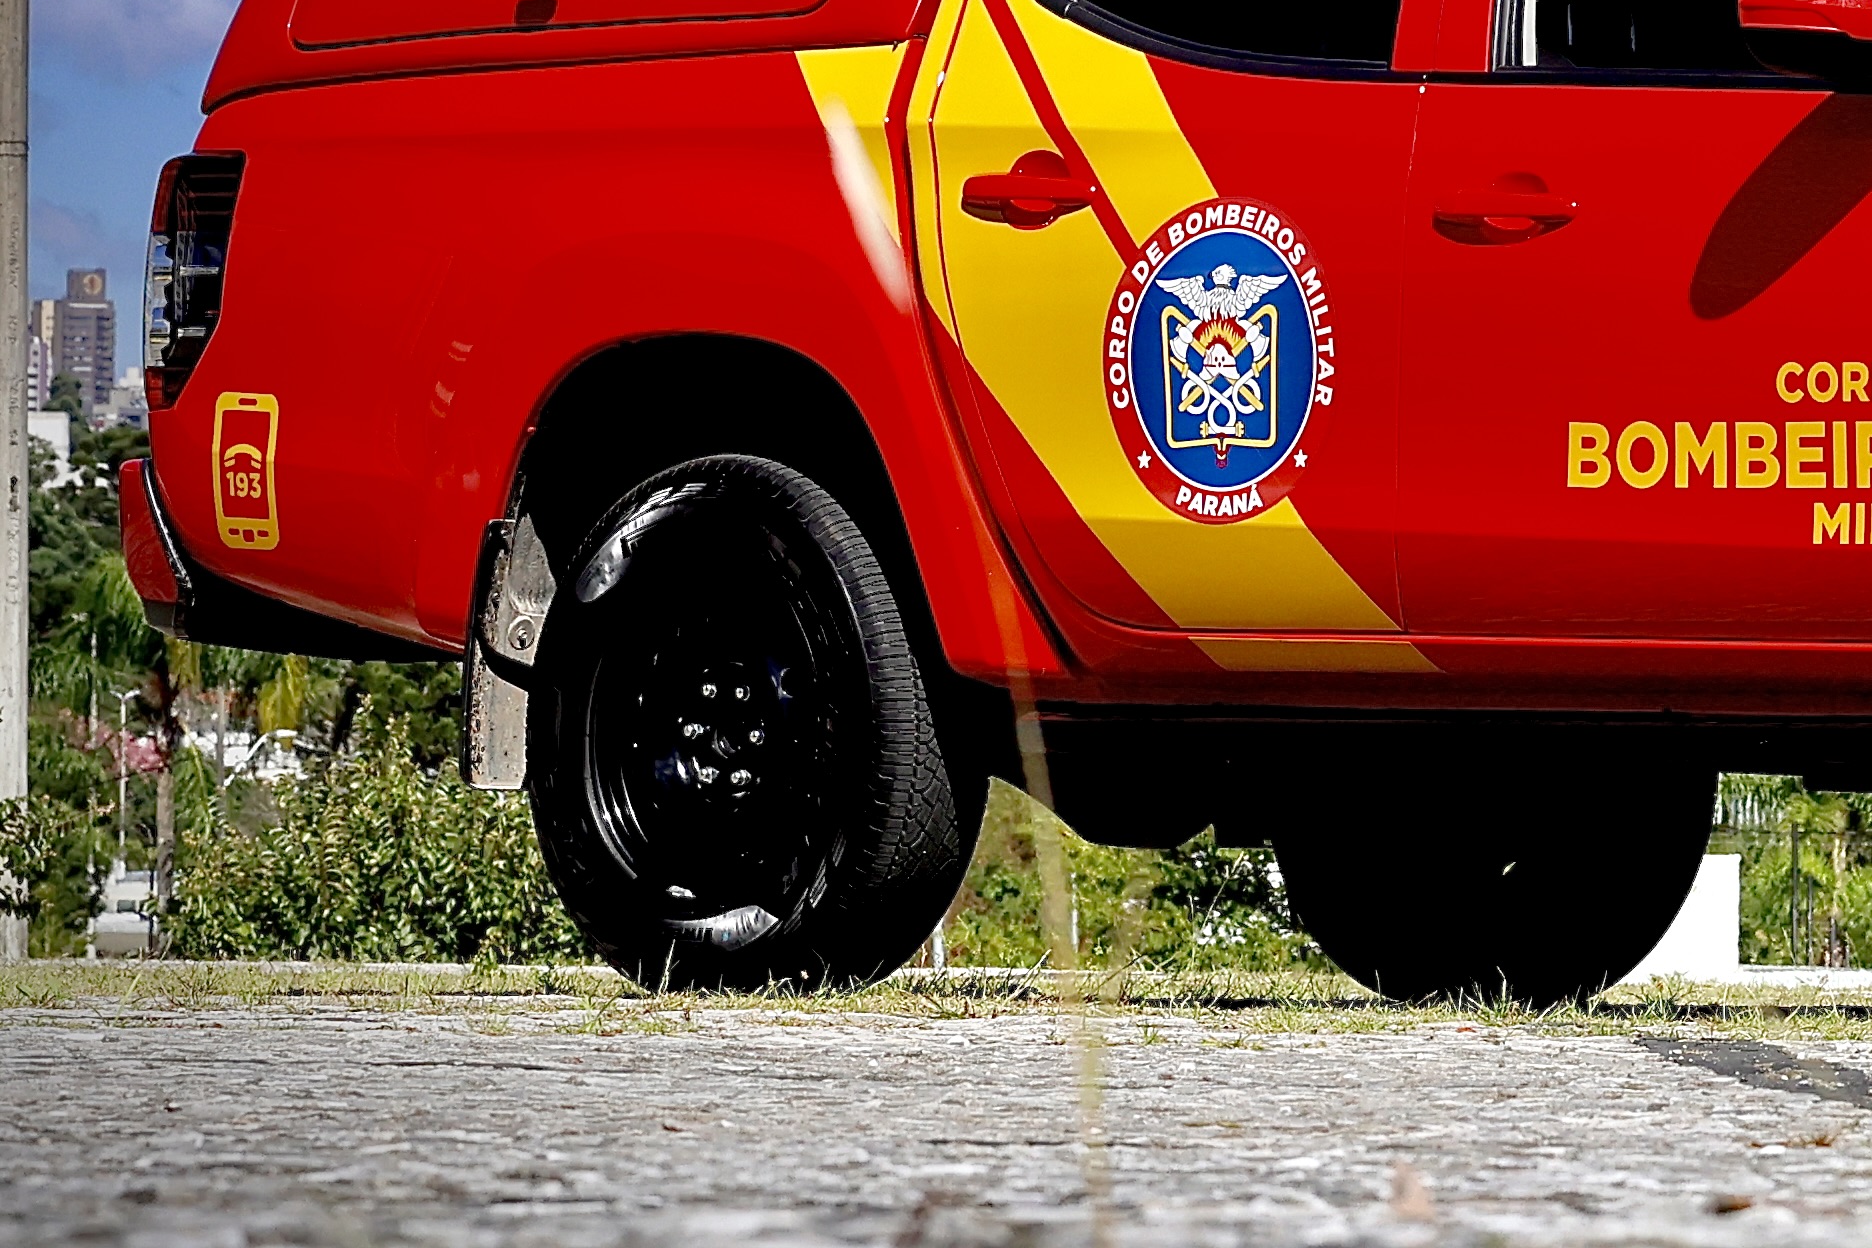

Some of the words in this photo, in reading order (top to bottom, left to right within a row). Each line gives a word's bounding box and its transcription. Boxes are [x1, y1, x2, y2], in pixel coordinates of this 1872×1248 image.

[1109, 290, 1135, 408] CORPO
[1131, 245, 1165, 285] DE
[1167, 204, 1307, 266] BOMBEIROS
[1301, 266, 1335, 406] MILITAR
[226, 471, 261, 499] 193
[1175, 484, 1264, 517] PARANÁ
